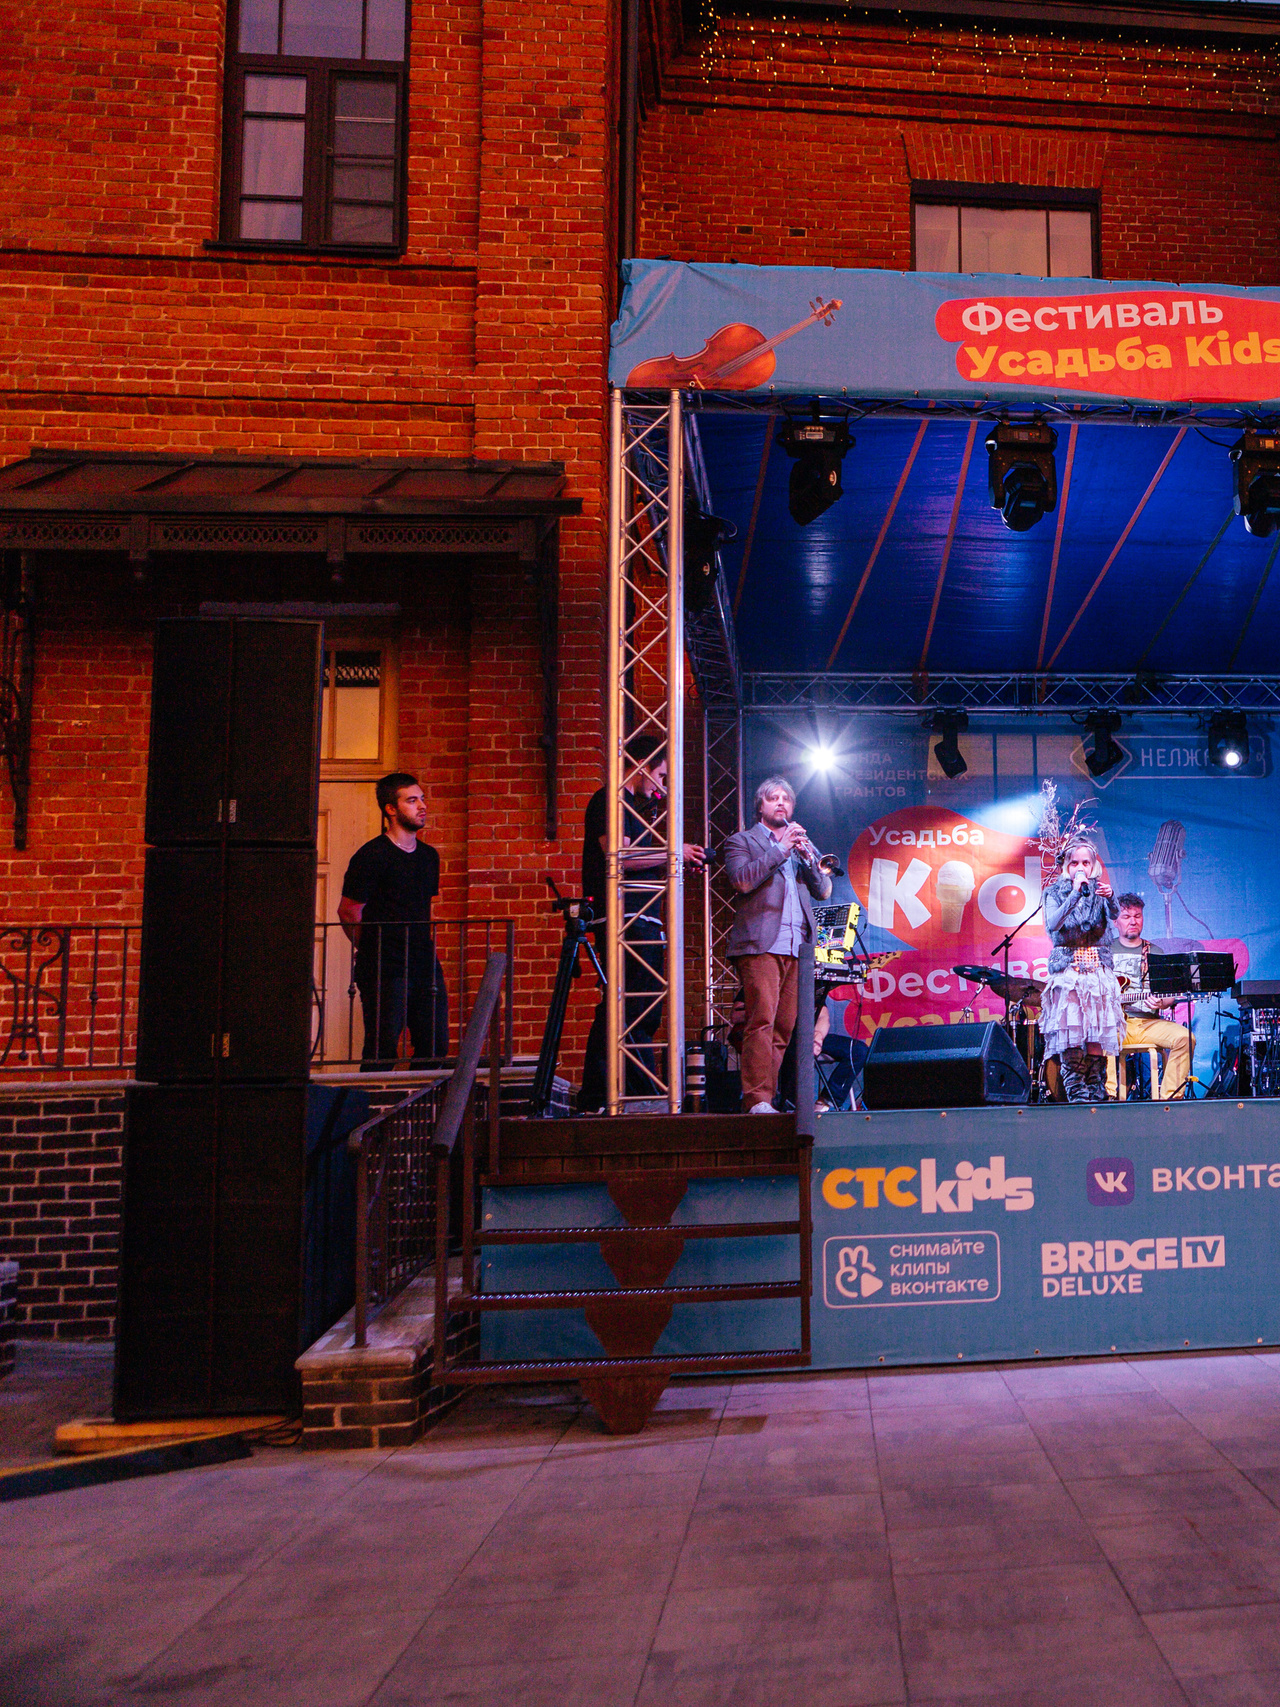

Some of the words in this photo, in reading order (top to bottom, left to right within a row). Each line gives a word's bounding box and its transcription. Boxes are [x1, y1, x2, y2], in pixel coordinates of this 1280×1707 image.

[962, 300, 1224, 336] Фестиваль
[964, 336, 1172, 379] Усадьба
[835, 787, 907, 798] ГРАНТОВ
[869, 825, 985, 849] Усадьба
[889, 1238, 985, 1258] снимайте
[1182, 1236, 1226, 1269] TV
[890, 1262, 951, 1277] клипы
[891, 1278, 990, 1296] вконтакте
[1042, 1273, 1144, 1298] DELUXE
